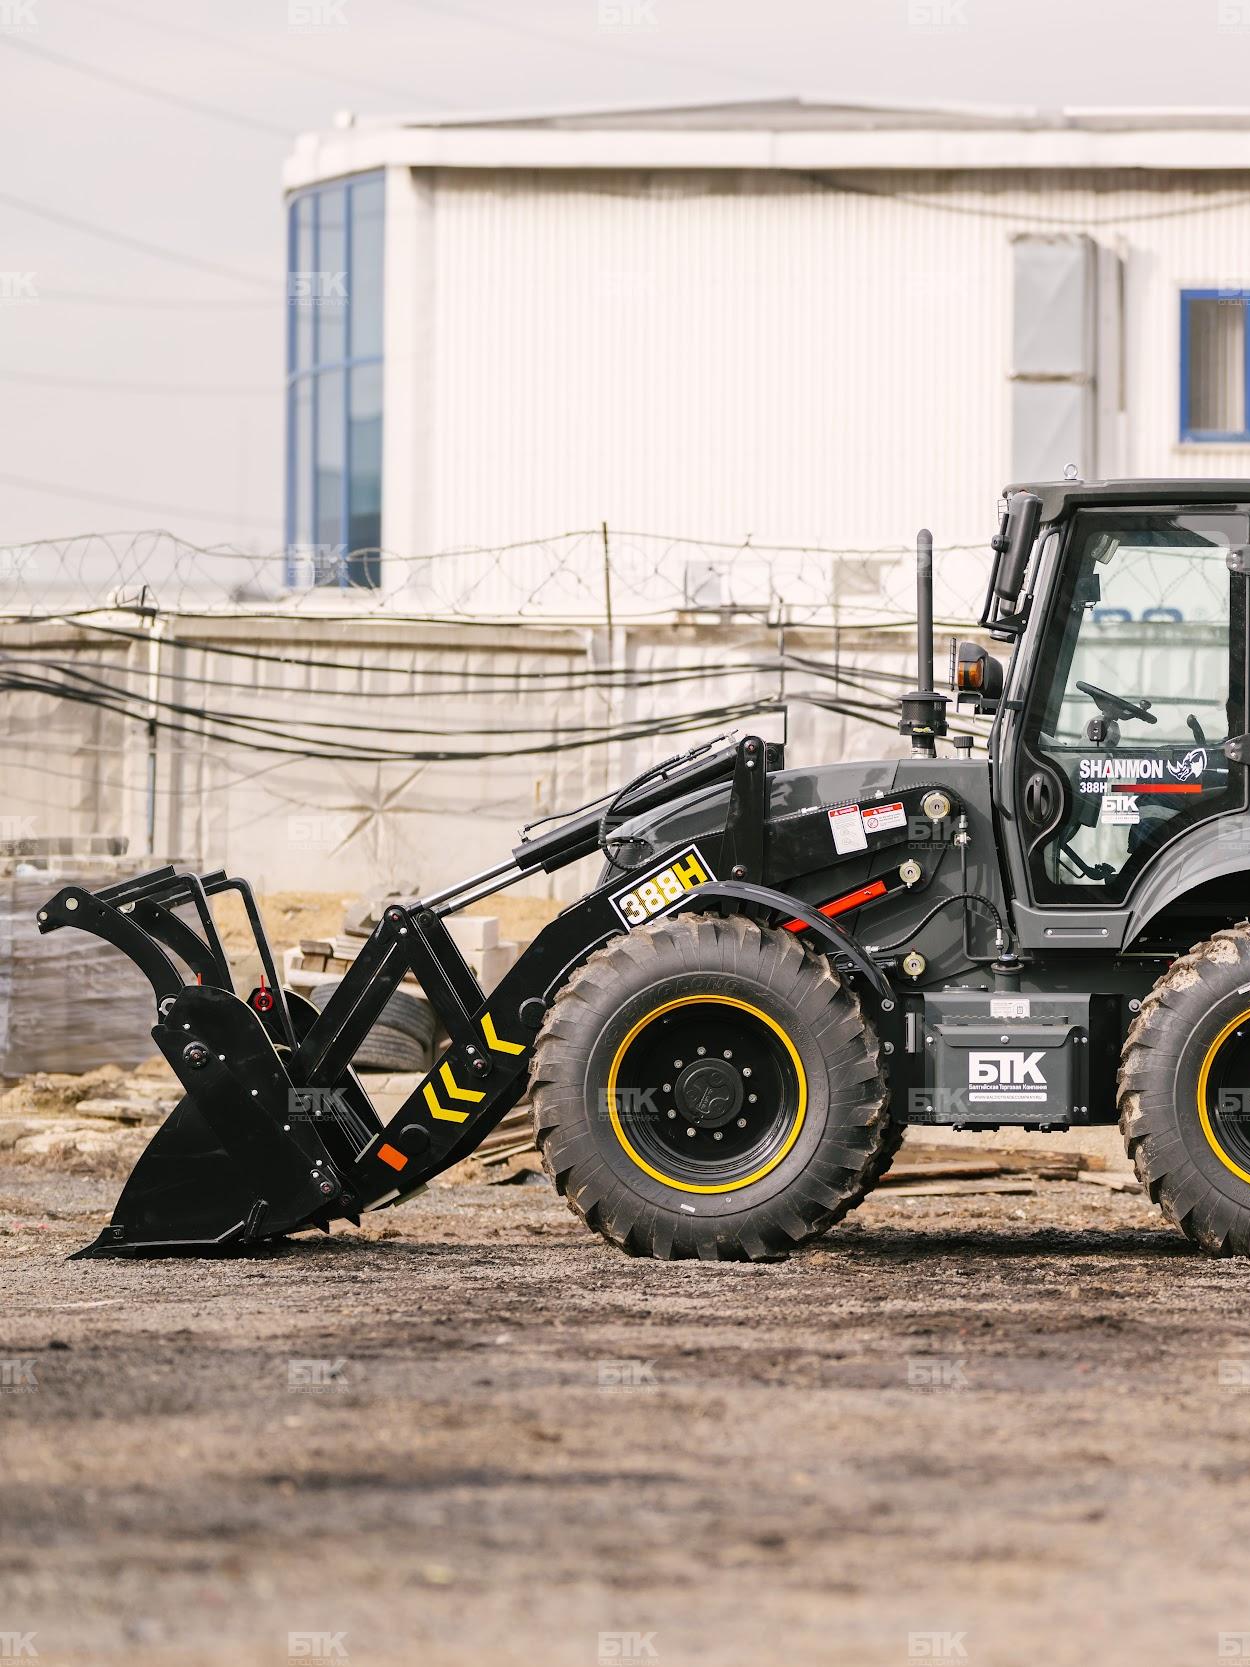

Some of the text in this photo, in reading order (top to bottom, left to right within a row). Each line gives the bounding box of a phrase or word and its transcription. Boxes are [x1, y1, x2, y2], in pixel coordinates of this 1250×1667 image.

[1080, 759, 1164, 779] SHANMON
[1079, 782, 1108, 793] 388H
[1101, 796, 1139, 812] БТК
[619, 853, 709, 925] 388H
[968, 1052, 1048, 1084] БТК
